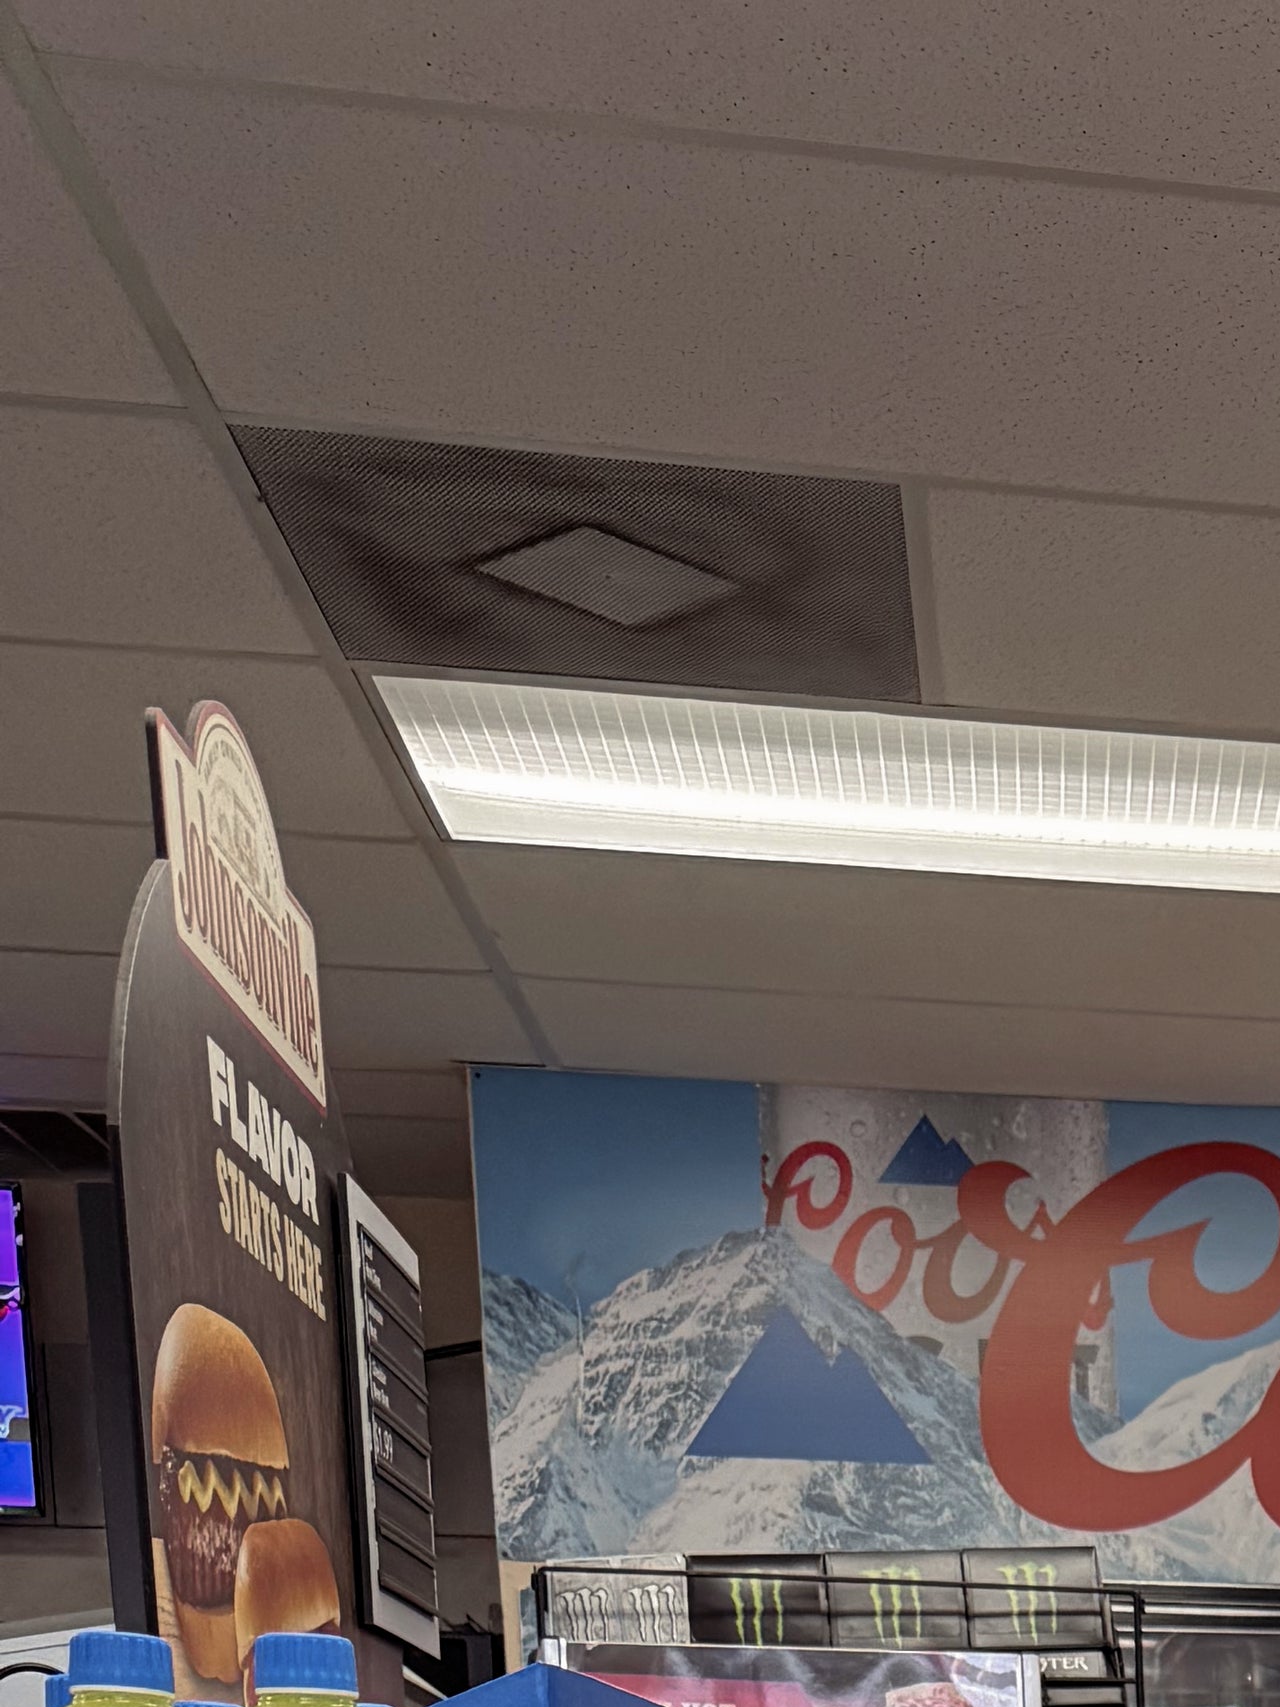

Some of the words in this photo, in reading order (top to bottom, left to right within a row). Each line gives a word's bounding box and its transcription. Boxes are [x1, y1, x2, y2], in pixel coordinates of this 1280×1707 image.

[206, 1035, 319, 1225] FLAVOR
[215, 1148, 284, 1284] STARTS
[285, 1209, 327, 1322] HERE
